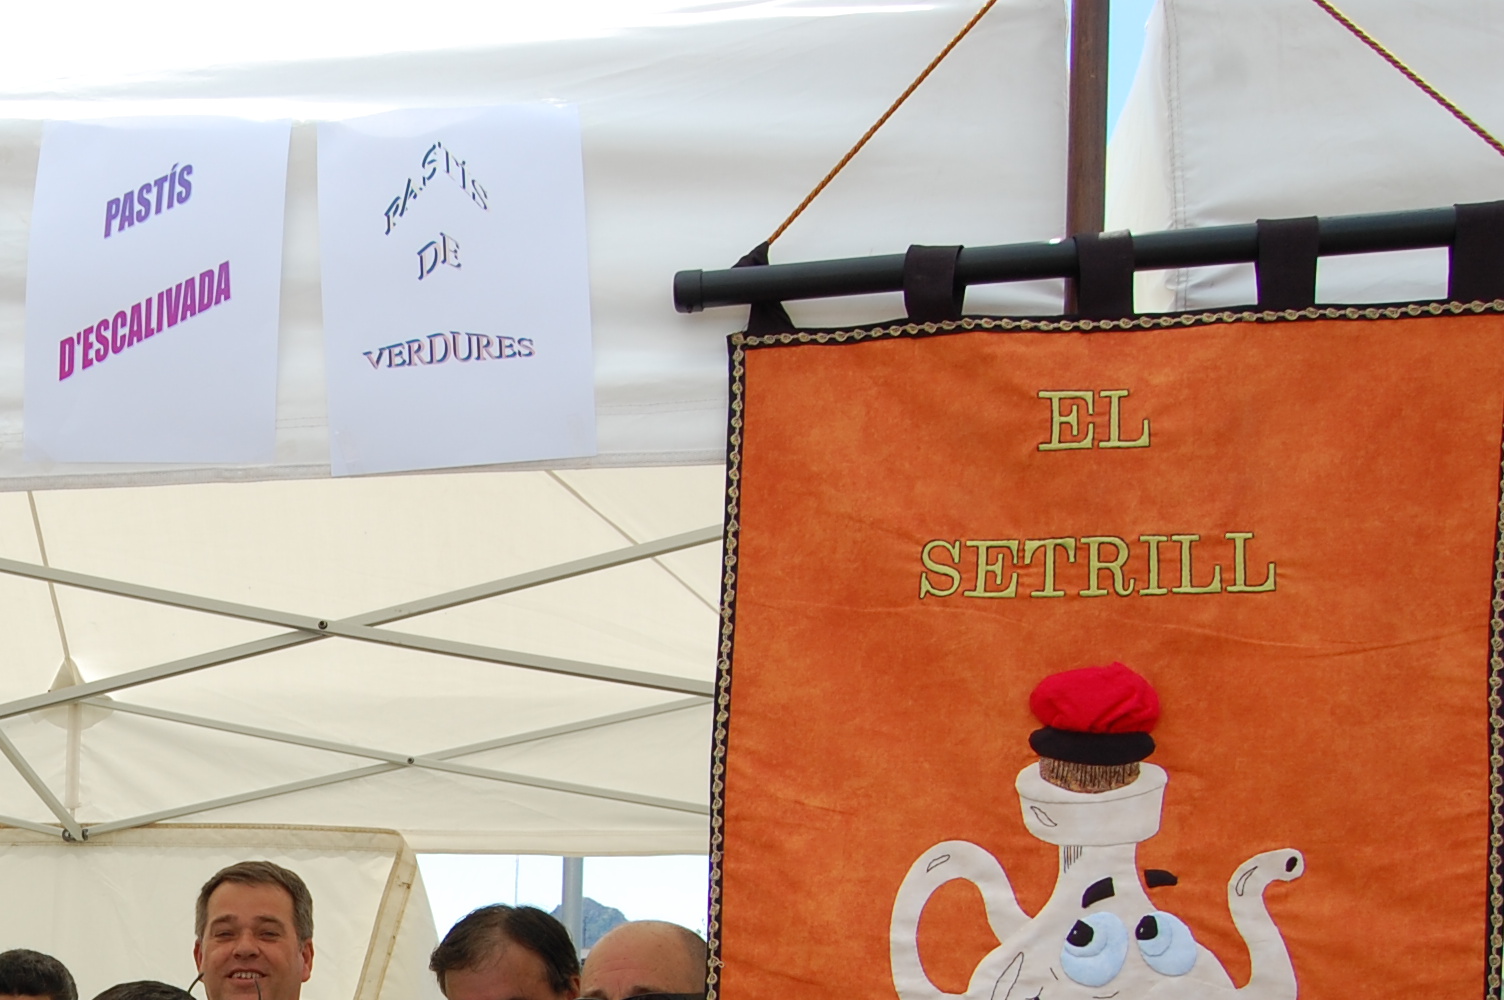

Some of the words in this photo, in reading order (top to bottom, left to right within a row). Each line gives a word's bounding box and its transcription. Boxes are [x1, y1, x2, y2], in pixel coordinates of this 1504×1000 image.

[104, 161, 193, 239] PASTÍS
[58, 260, 232, 382] D'ESCALIVADA
[362, 330, 534, 370] VERDURES
[1035, 388, 1153, 453] EL
[918, 531, 1278, 601] SETRILL
